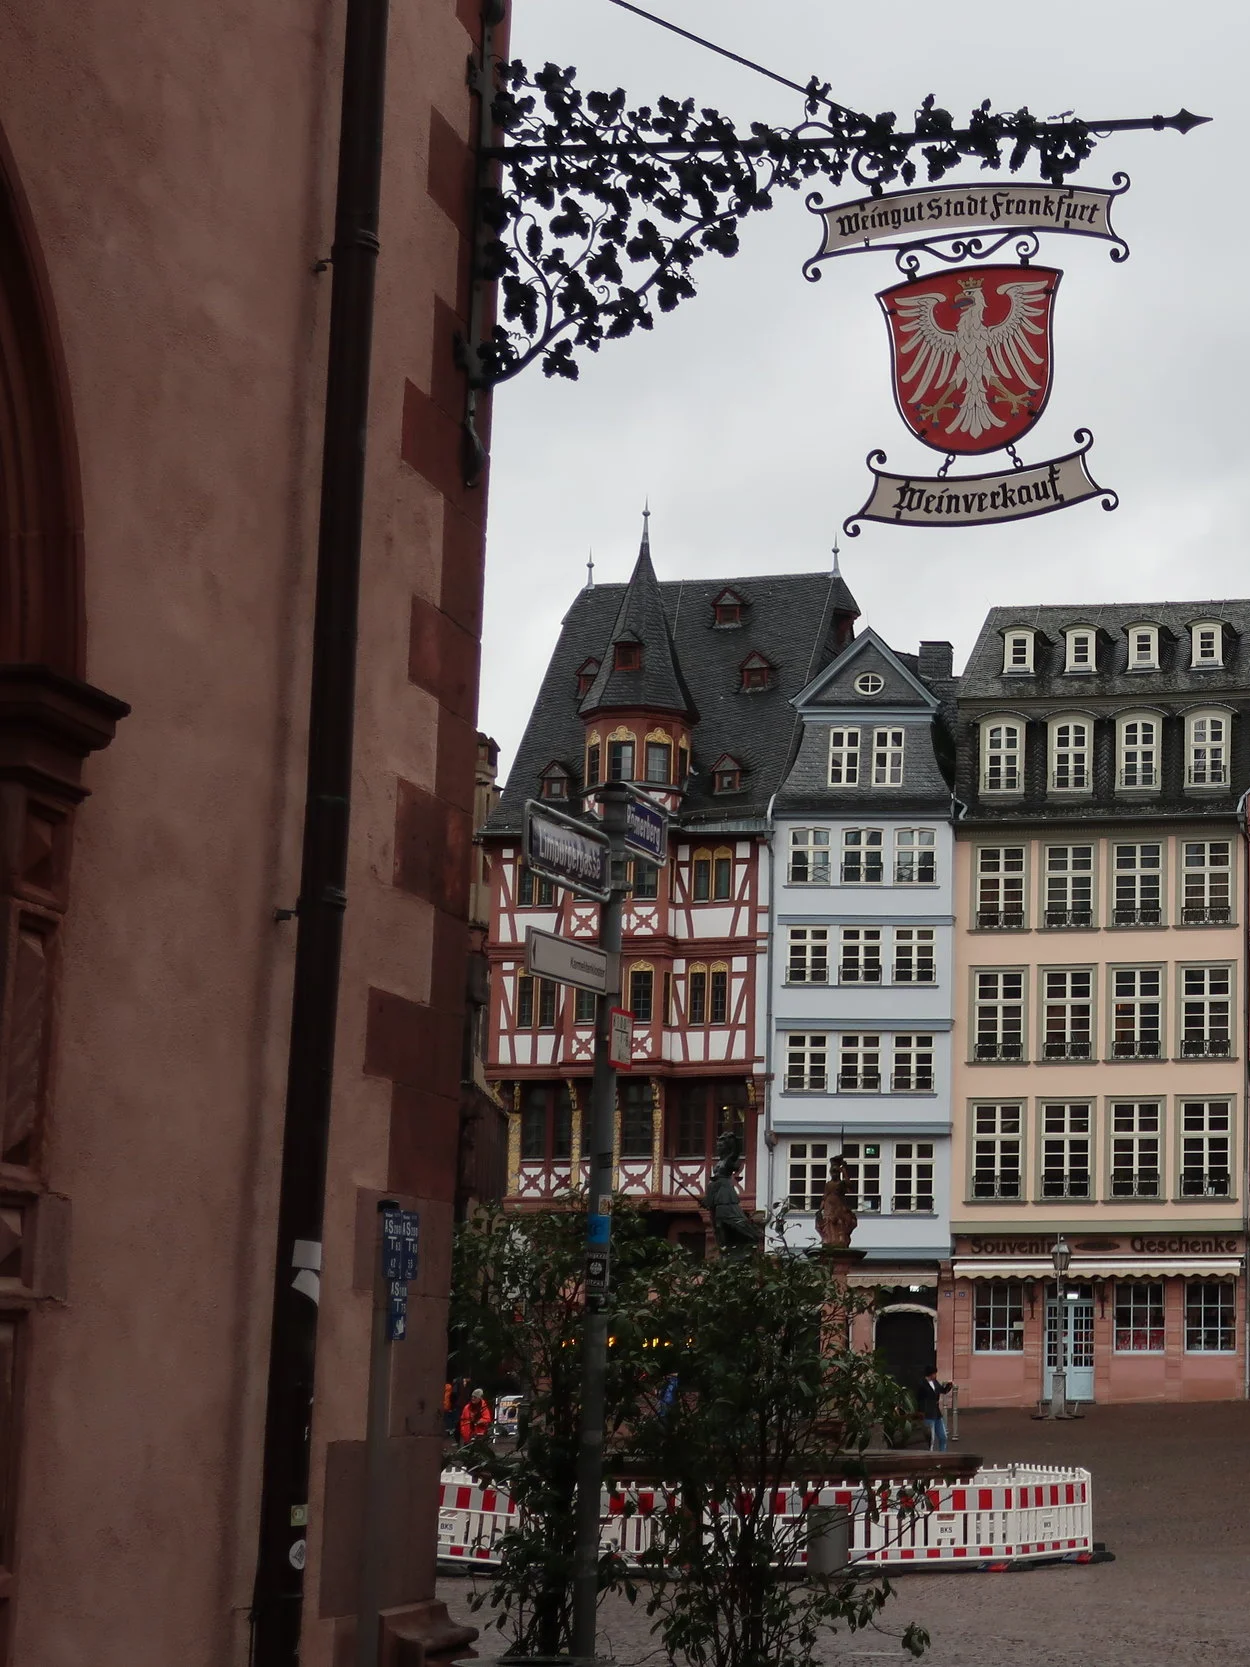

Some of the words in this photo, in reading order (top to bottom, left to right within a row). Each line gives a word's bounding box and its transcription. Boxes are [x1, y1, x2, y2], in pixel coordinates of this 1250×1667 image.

[836, 202, 925, 236] Weingut
[927, 194, 987, 221] Stadt
[989, 191, 1100, 224] Frankfurt
[893, 466, 1062, 515] Weinverkauf
[626, 804, 661, 852] Römerberg
[1130, 1236, 1238, 1254] Geschenke
[440, 1522, 454, 1531] BKS
[940, 1526, 953, 1534] BKS
